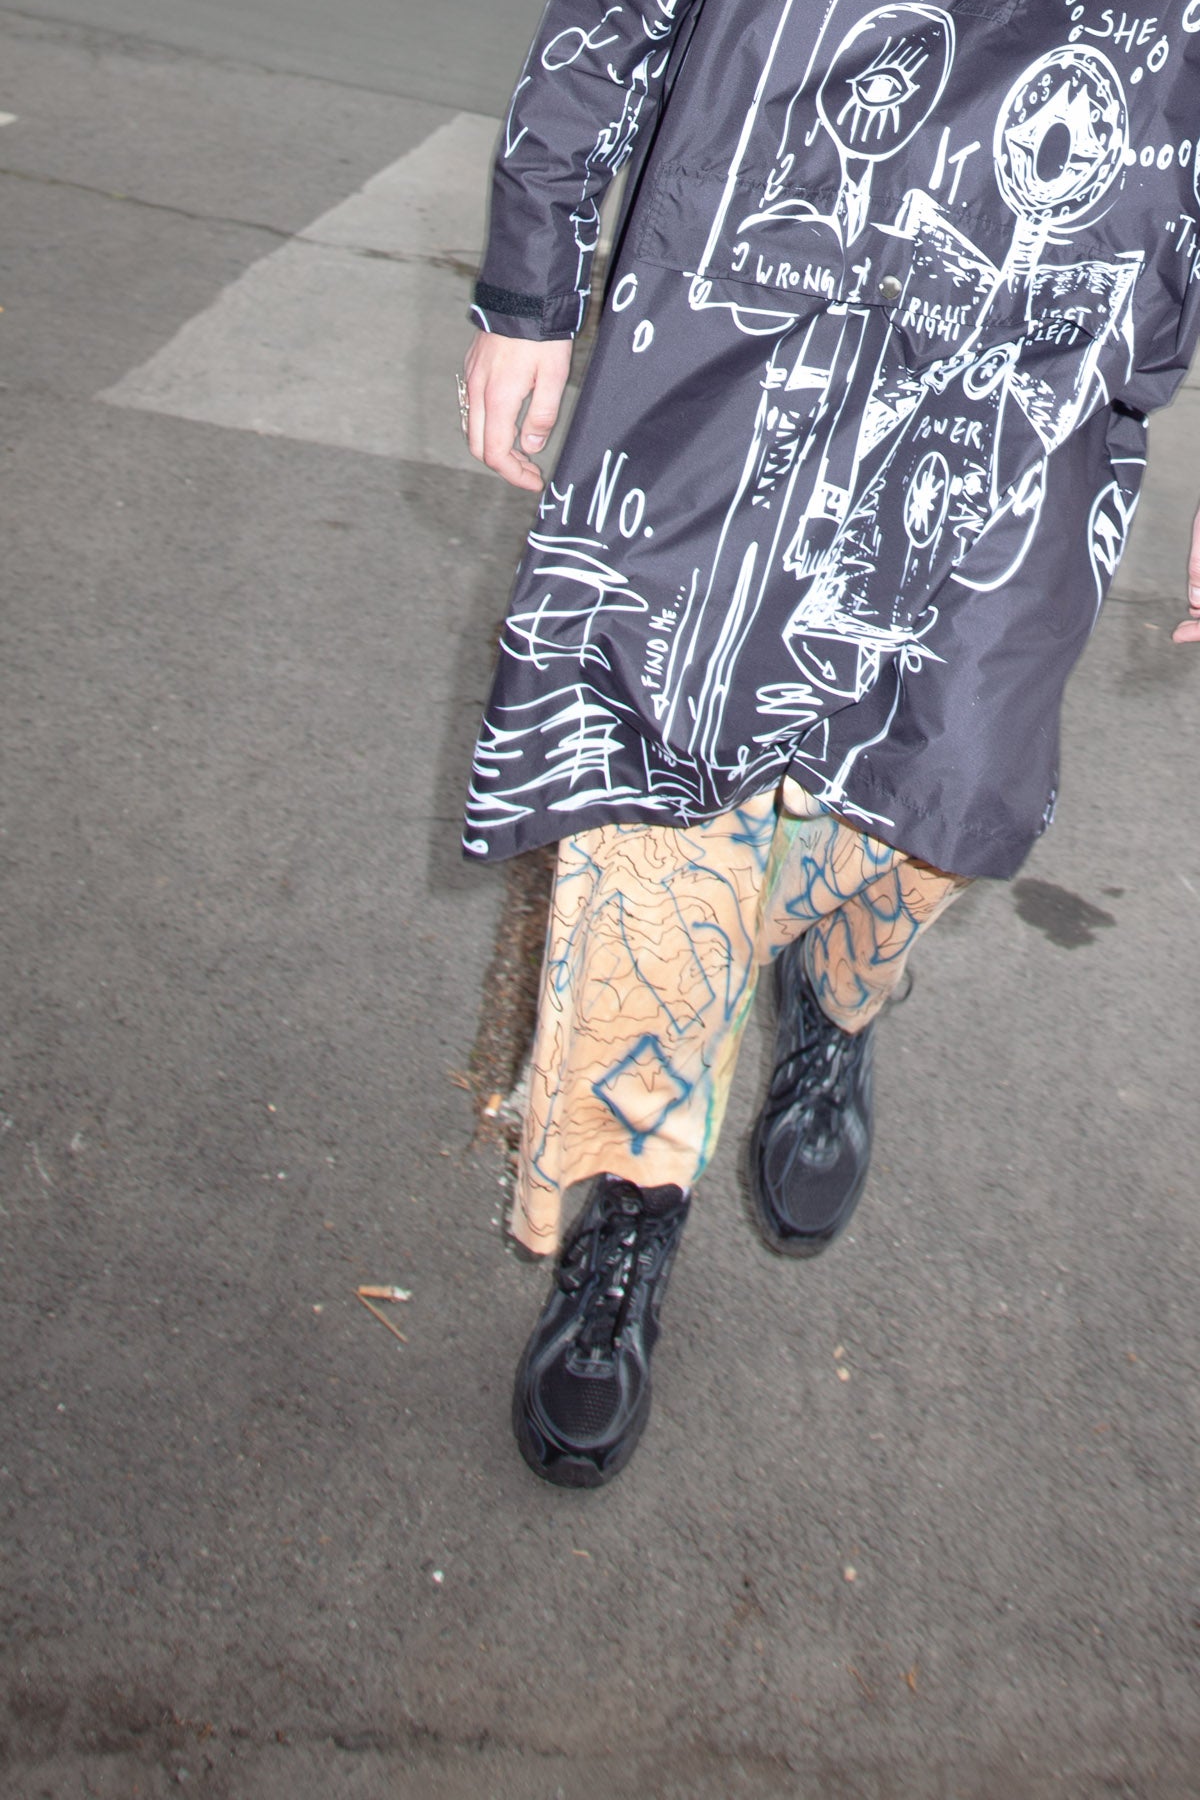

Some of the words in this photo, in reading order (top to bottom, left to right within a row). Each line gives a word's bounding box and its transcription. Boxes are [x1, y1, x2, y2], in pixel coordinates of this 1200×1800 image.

[1084, 9, 1158, 53] SHE
[928, 126, 981, 205] IT
[912, 415, 982, 450] POWER
[640, 637, 670, 689] FIND
